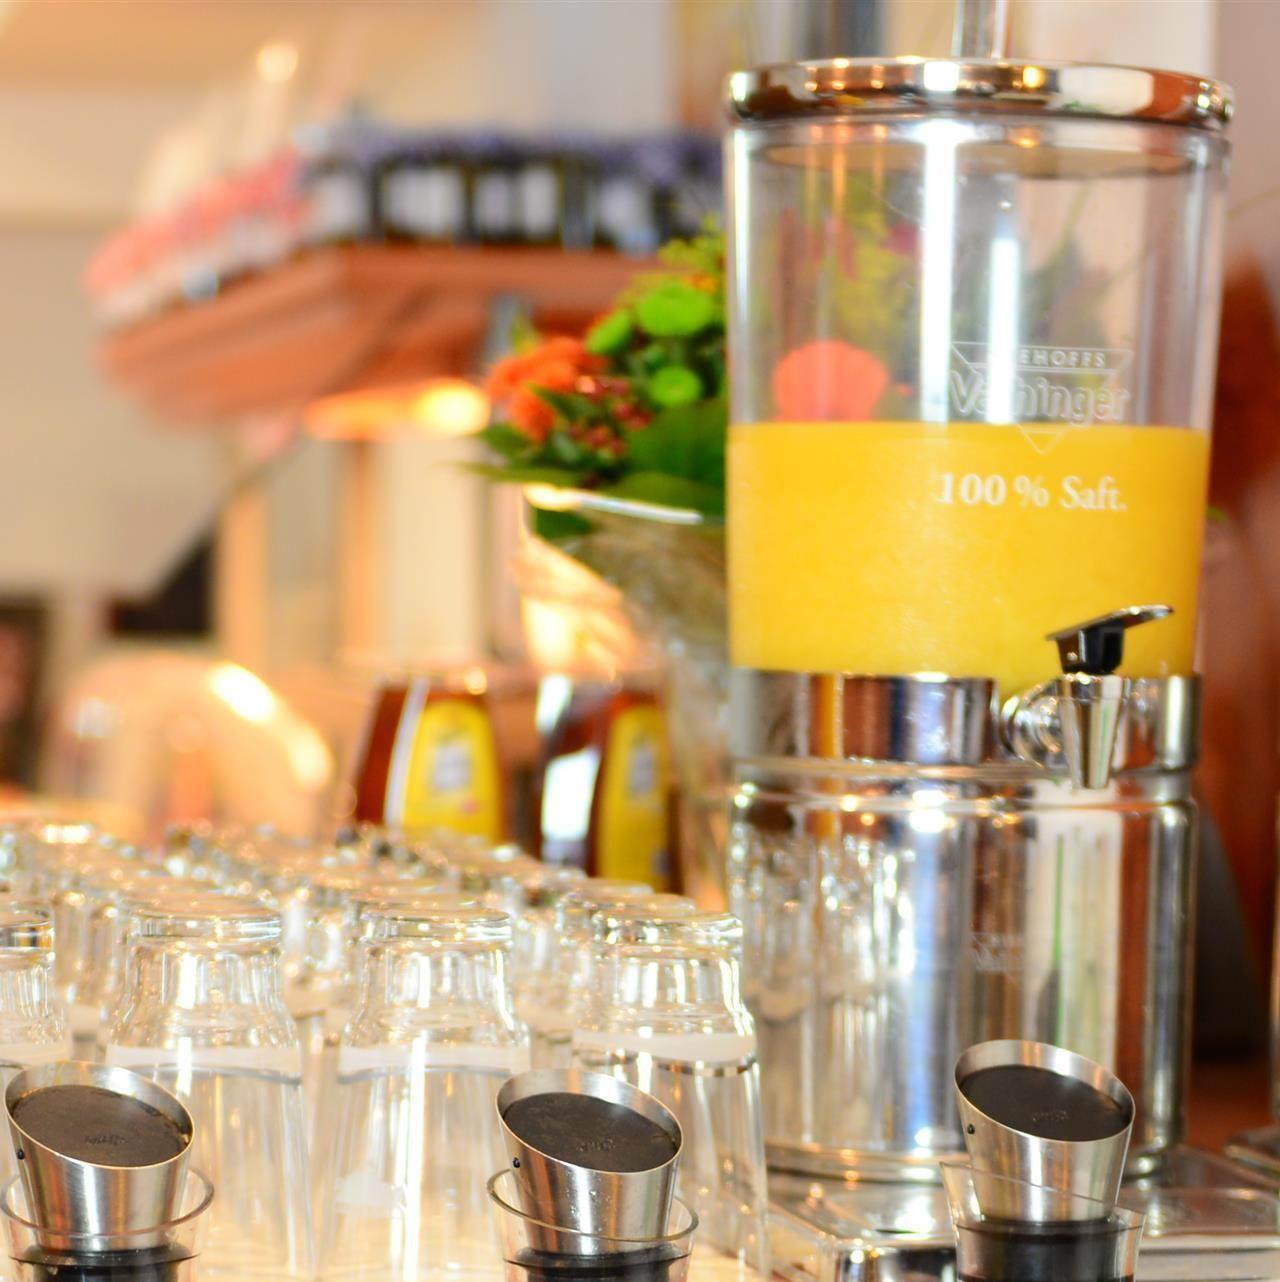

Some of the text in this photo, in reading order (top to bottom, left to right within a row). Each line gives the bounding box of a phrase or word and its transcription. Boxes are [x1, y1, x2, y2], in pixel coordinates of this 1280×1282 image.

[936, 472, 1128, 512] 100 % Saft.
